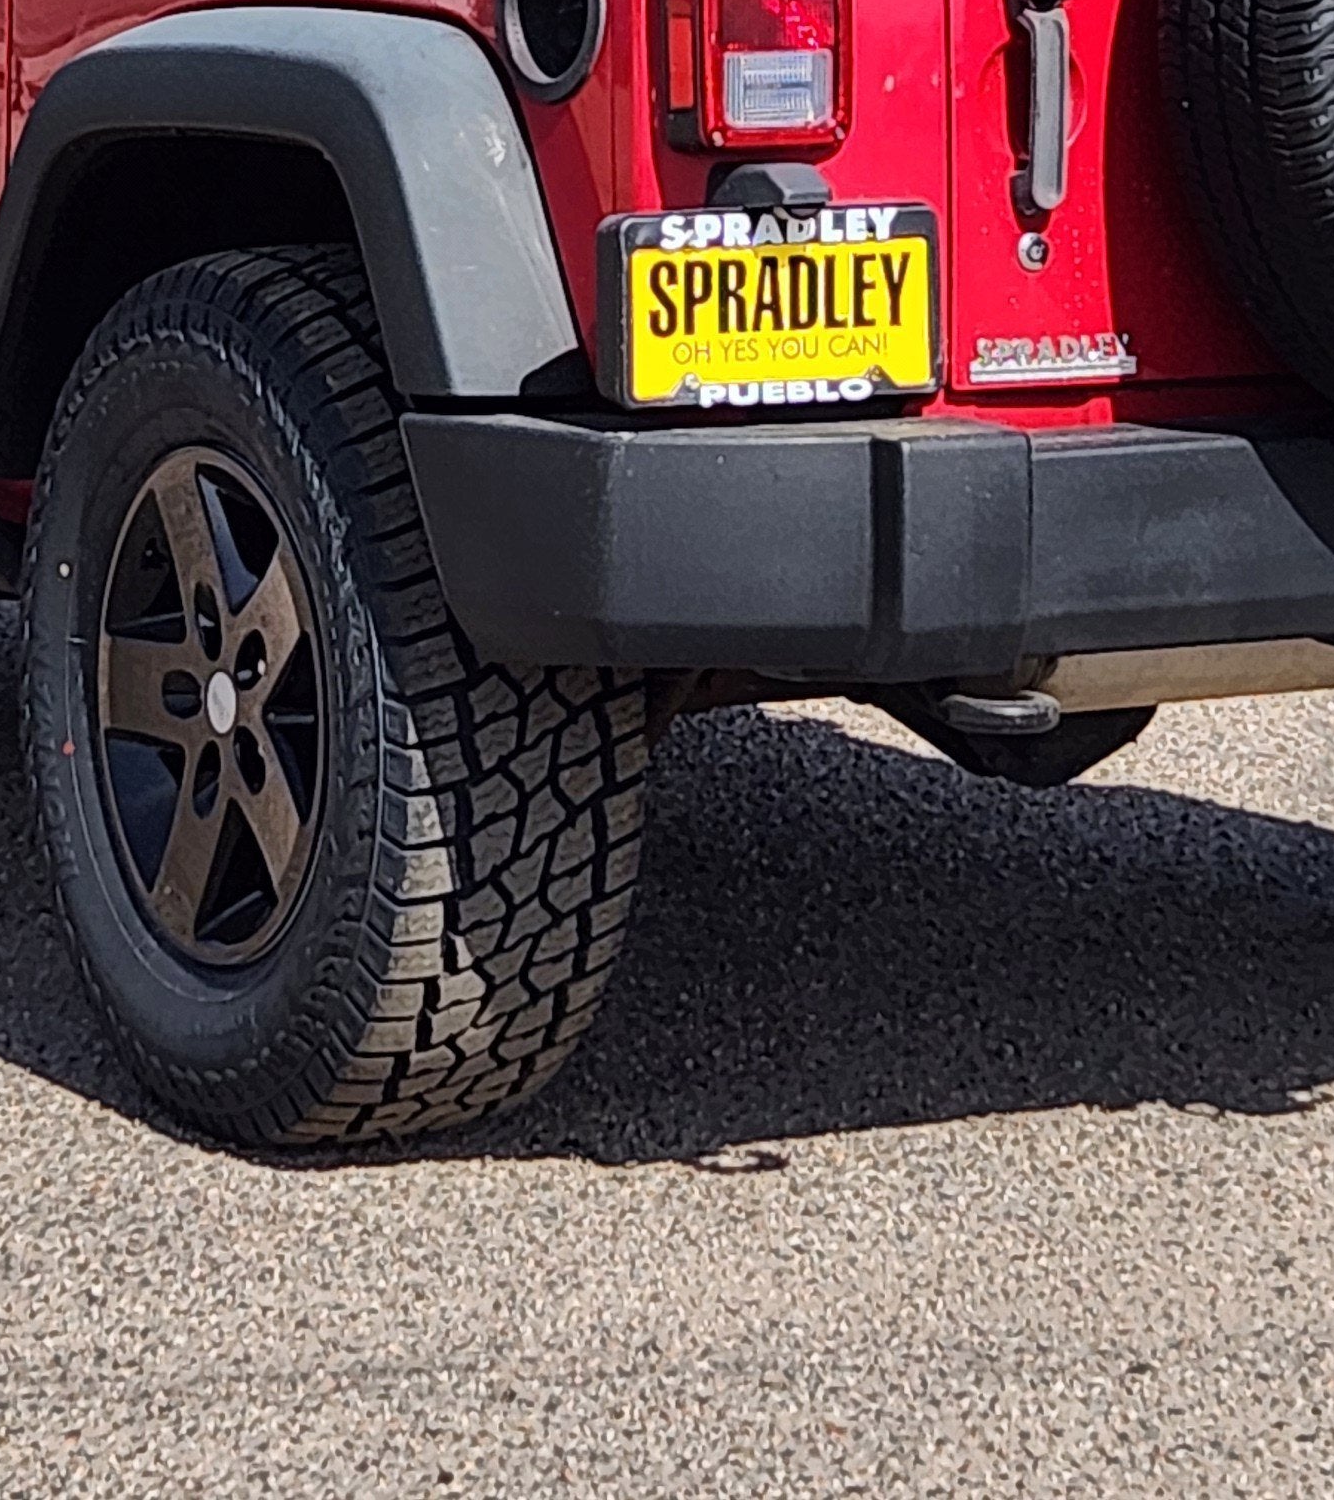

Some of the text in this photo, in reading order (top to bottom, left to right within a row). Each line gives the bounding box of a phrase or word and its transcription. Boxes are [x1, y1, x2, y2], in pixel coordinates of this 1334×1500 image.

[660, 207, 898, 250] SPRADLEY
[649, 252, 911, 338] SPRADLEY
[673, 332, 888, 366] OH YES YOU CAN!
[976, 332, 1129, 367] SPRADLEY
[700, 377, 873, 409] PUEBLO
